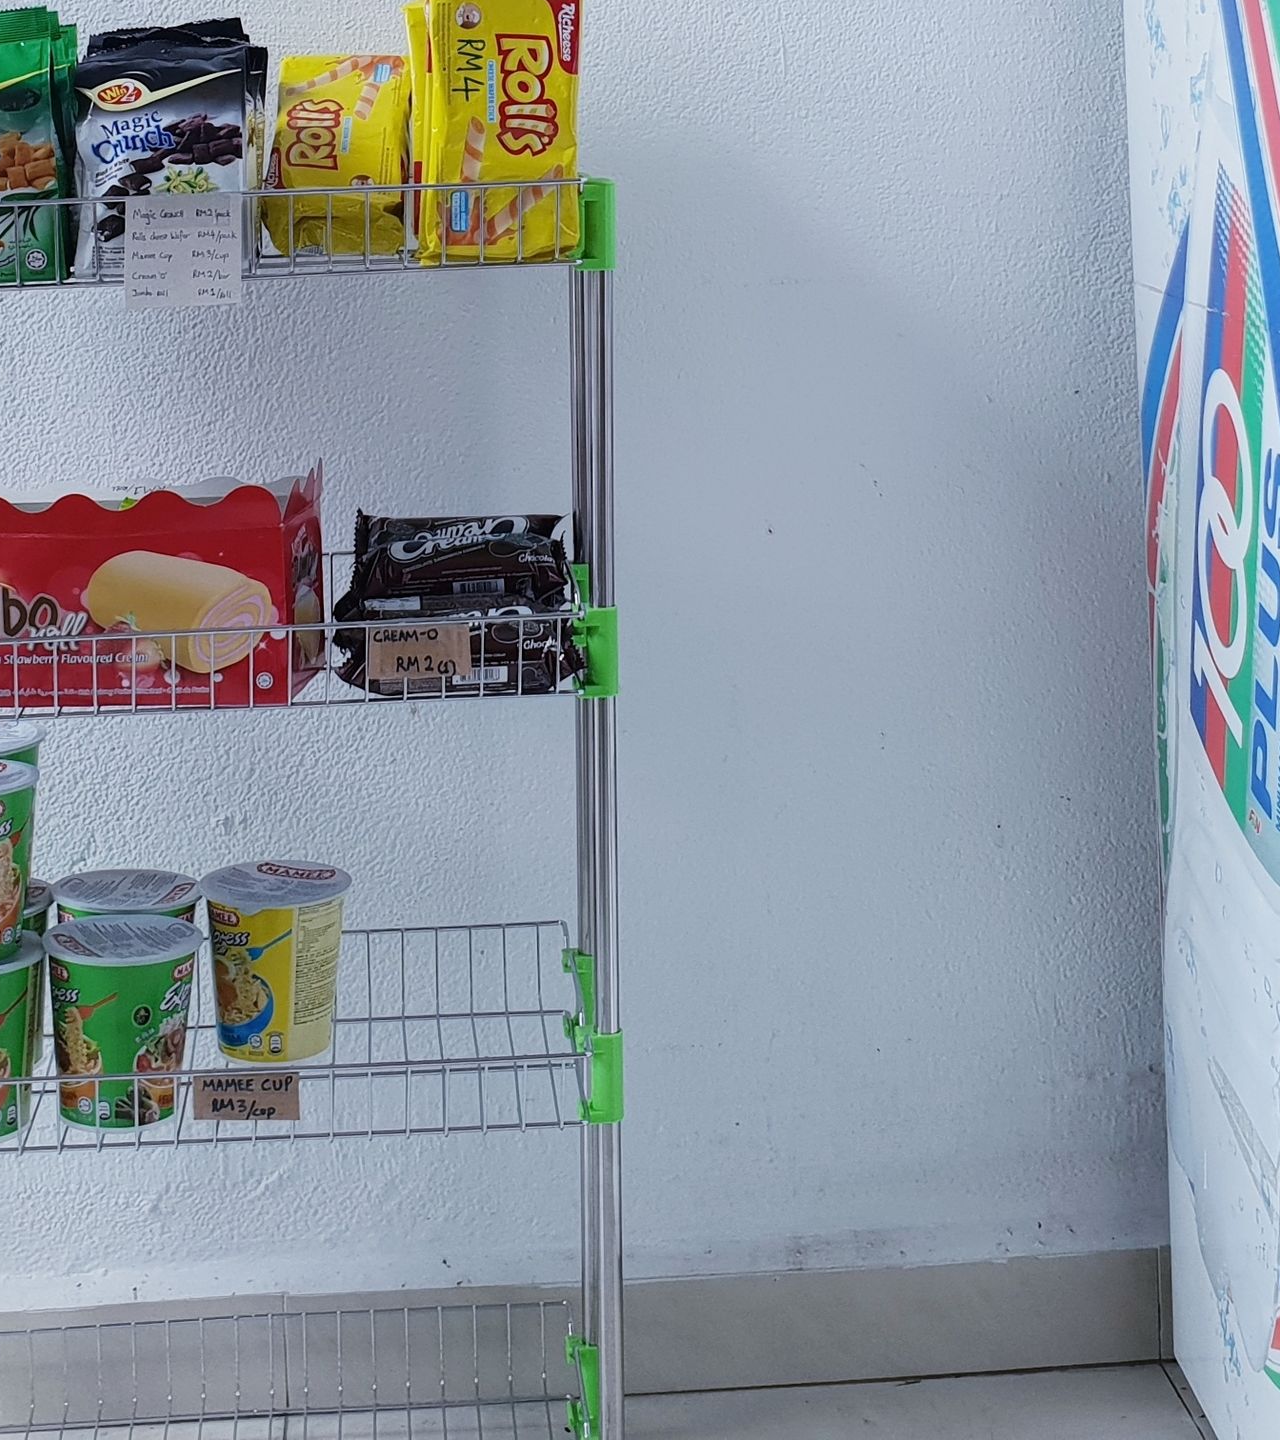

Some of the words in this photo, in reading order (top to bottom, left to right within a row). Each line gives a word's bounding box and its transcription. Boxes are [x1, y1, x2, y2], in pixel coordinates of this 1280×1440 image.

[101, 110, 163, 139] Magic
[91, 124, 177, 165] Crunch
[373, 628, 439, 643] CREAM-O
[201, 1078, 255, 1092] MAMEE
[261, 1075, 293, 1091] CUP
